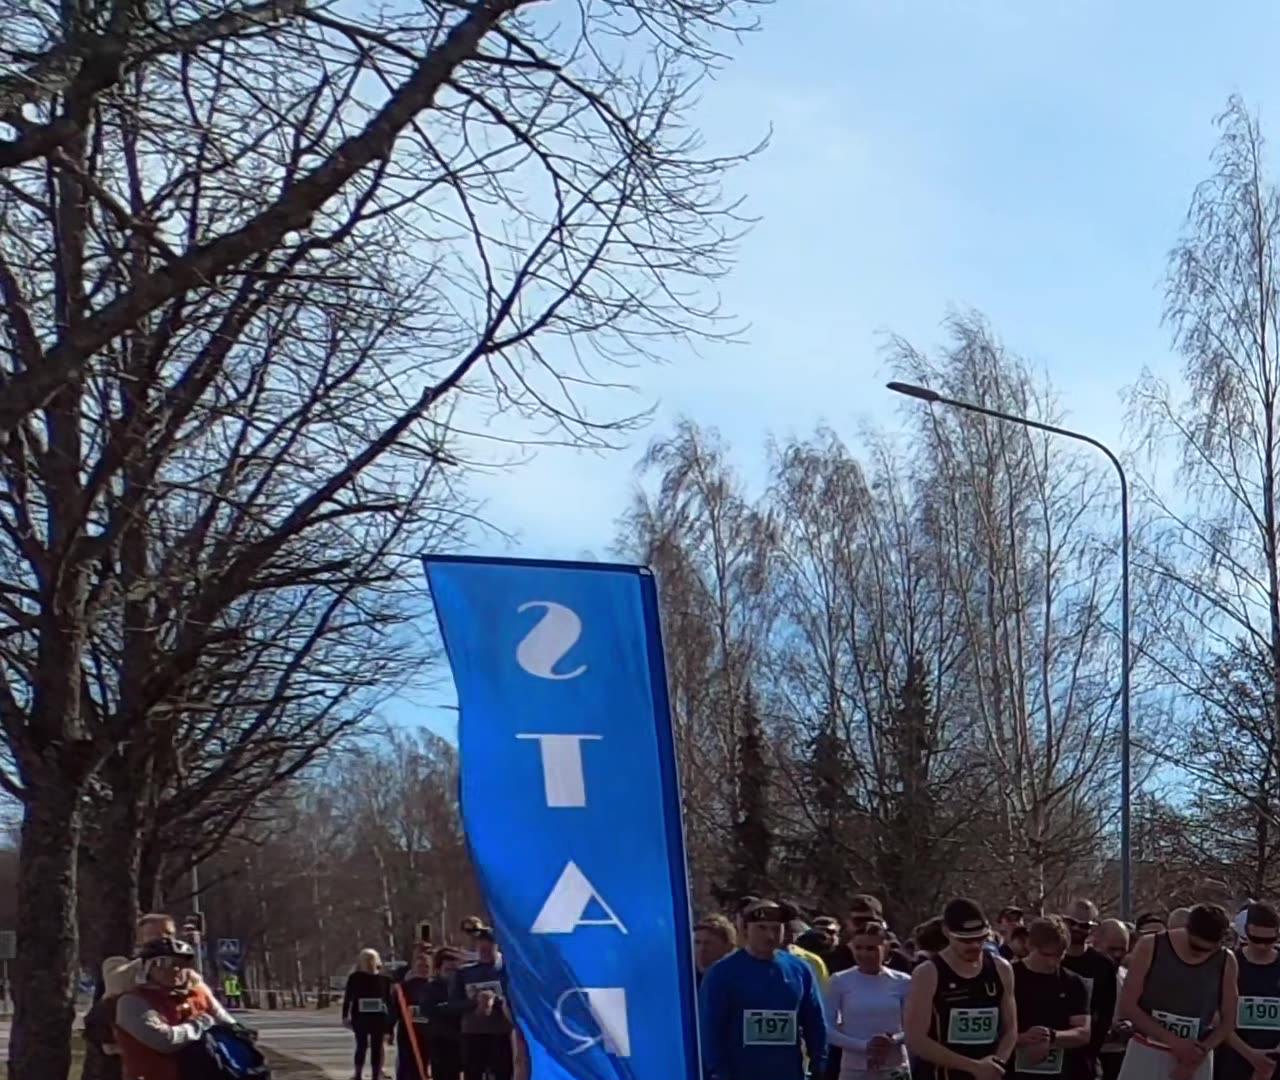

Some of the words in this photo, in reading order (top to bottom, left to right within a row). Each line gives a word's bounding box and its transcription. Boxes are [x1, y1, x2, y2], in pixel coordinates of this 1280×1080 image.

[1245, 1004, 1278, 1019] 190
[754, 1018, 789, 1033] 197
[957, 1016, 992, 1032] 359
